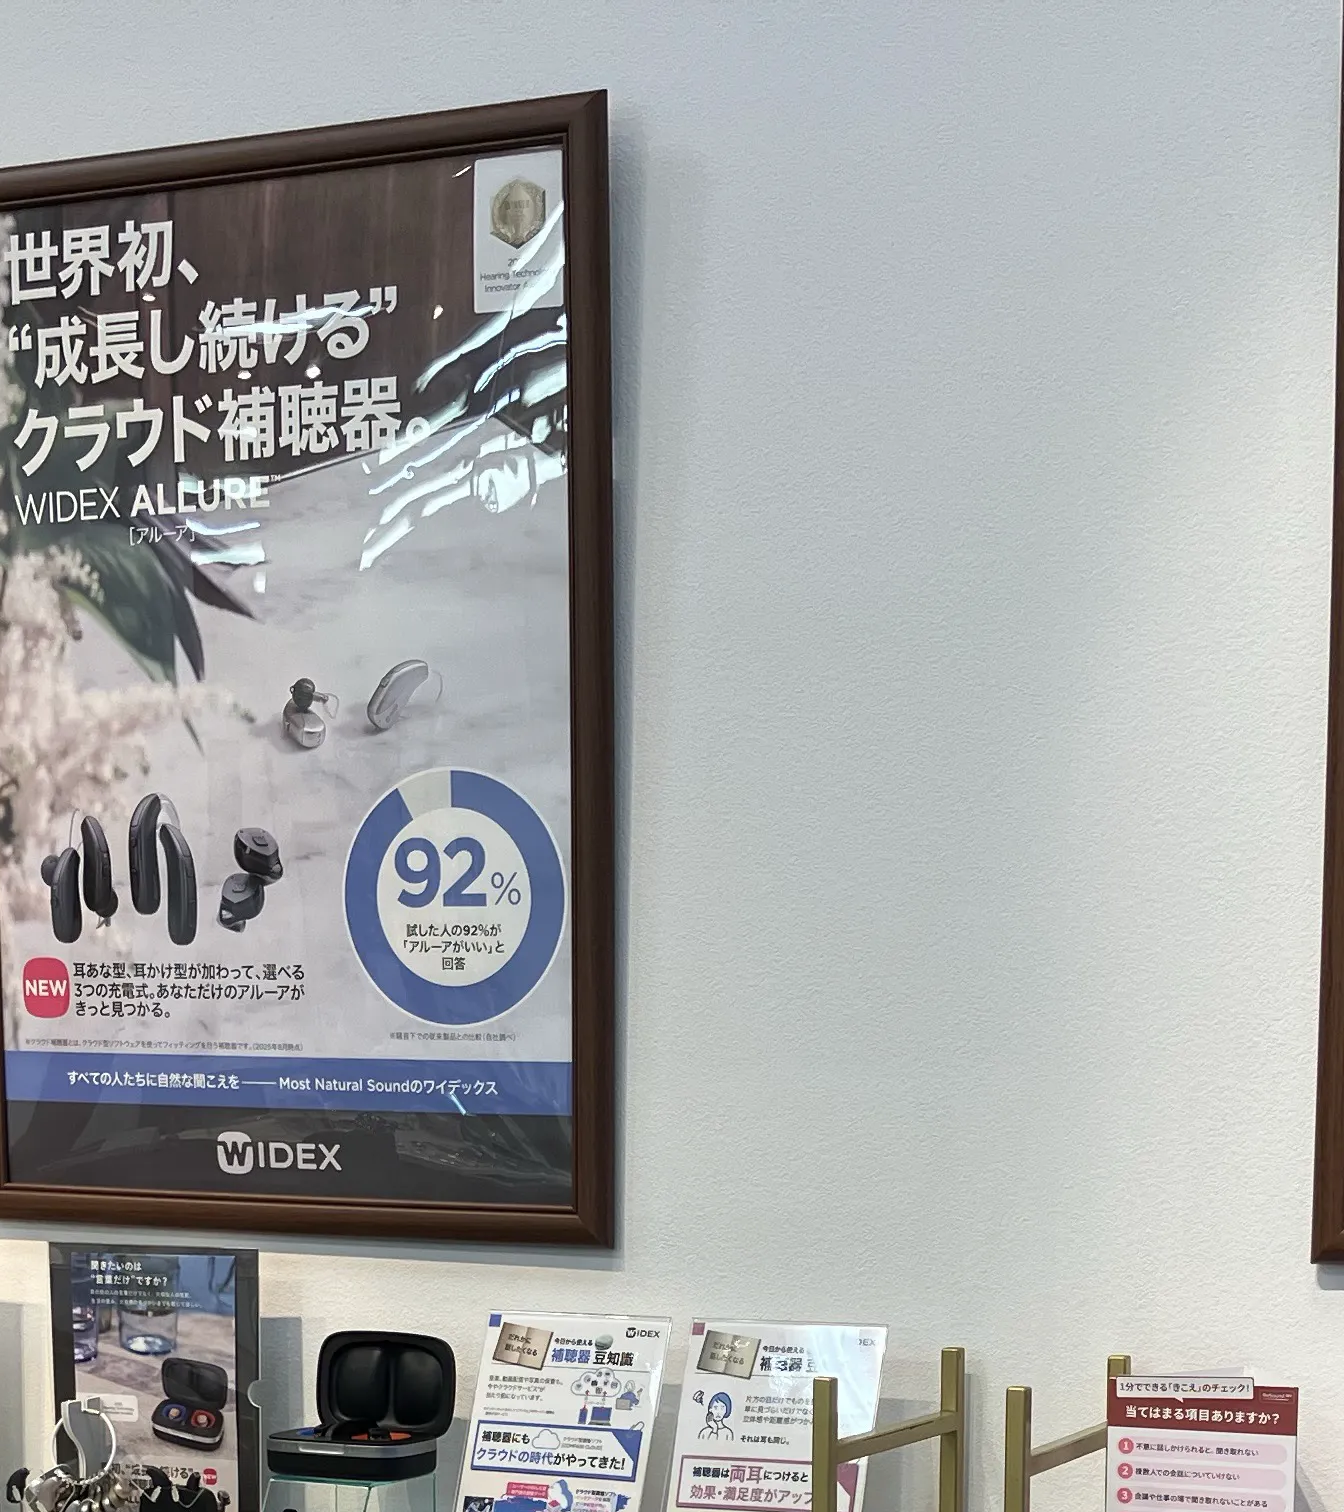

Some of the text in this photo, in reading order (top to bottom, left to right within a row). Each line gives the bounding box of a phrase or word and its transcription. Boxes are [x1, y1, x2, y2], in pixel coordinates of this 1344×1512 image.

[4, 219, 200, 307] 世界初、
[8, 285, 399, 389] “成長し続ける”
[13, 376, 431, 478] クラウド補聴器。
[14, 487, 121, 527] WIDEX
[392, 837, 523, 909] 92%
[406, 924, 502, 938] 試した人の92%が
[403, 940, 506, 955] 「アルーアがいい」と
[72, 962, 306, 981] 耳あな型、耳かけ型が加わって、選べる
[441, 956, 467, 971] 回答
[24, 978, 68, 997] NEW
[73, 982, 306, 1001] 3つの充電式。あなただけのアルーアが
[75, 1001, 172, 1019] きっと見つかる。
[278, 1076, 312, 1092] Most
[315, 1077, 364, 1094] Natural
[366, 1078, 499, 1096] Soundのワイデックス
[216, 1130, 343, 1175] WIDEX
[625, 1327, 661, 1339] WIDEX
[551, 1348, 634, 1367] 補聴器 豆知識
[1119, 1381, 1251, 1394] 1分でできる「きこえ」のチェック！
[1124, 1404, 1280, 1426] 当てはまる項目ありますか？
[481, 1430, 531, 1445] 補聴器にも
[739, 1435, 791, 1446] それは耳も同じ。
[475, 1447, 626, 1471] クラウドの時代がやってきた！
[692, 1464, 809, 1485] 補聴器は両耳につけると
